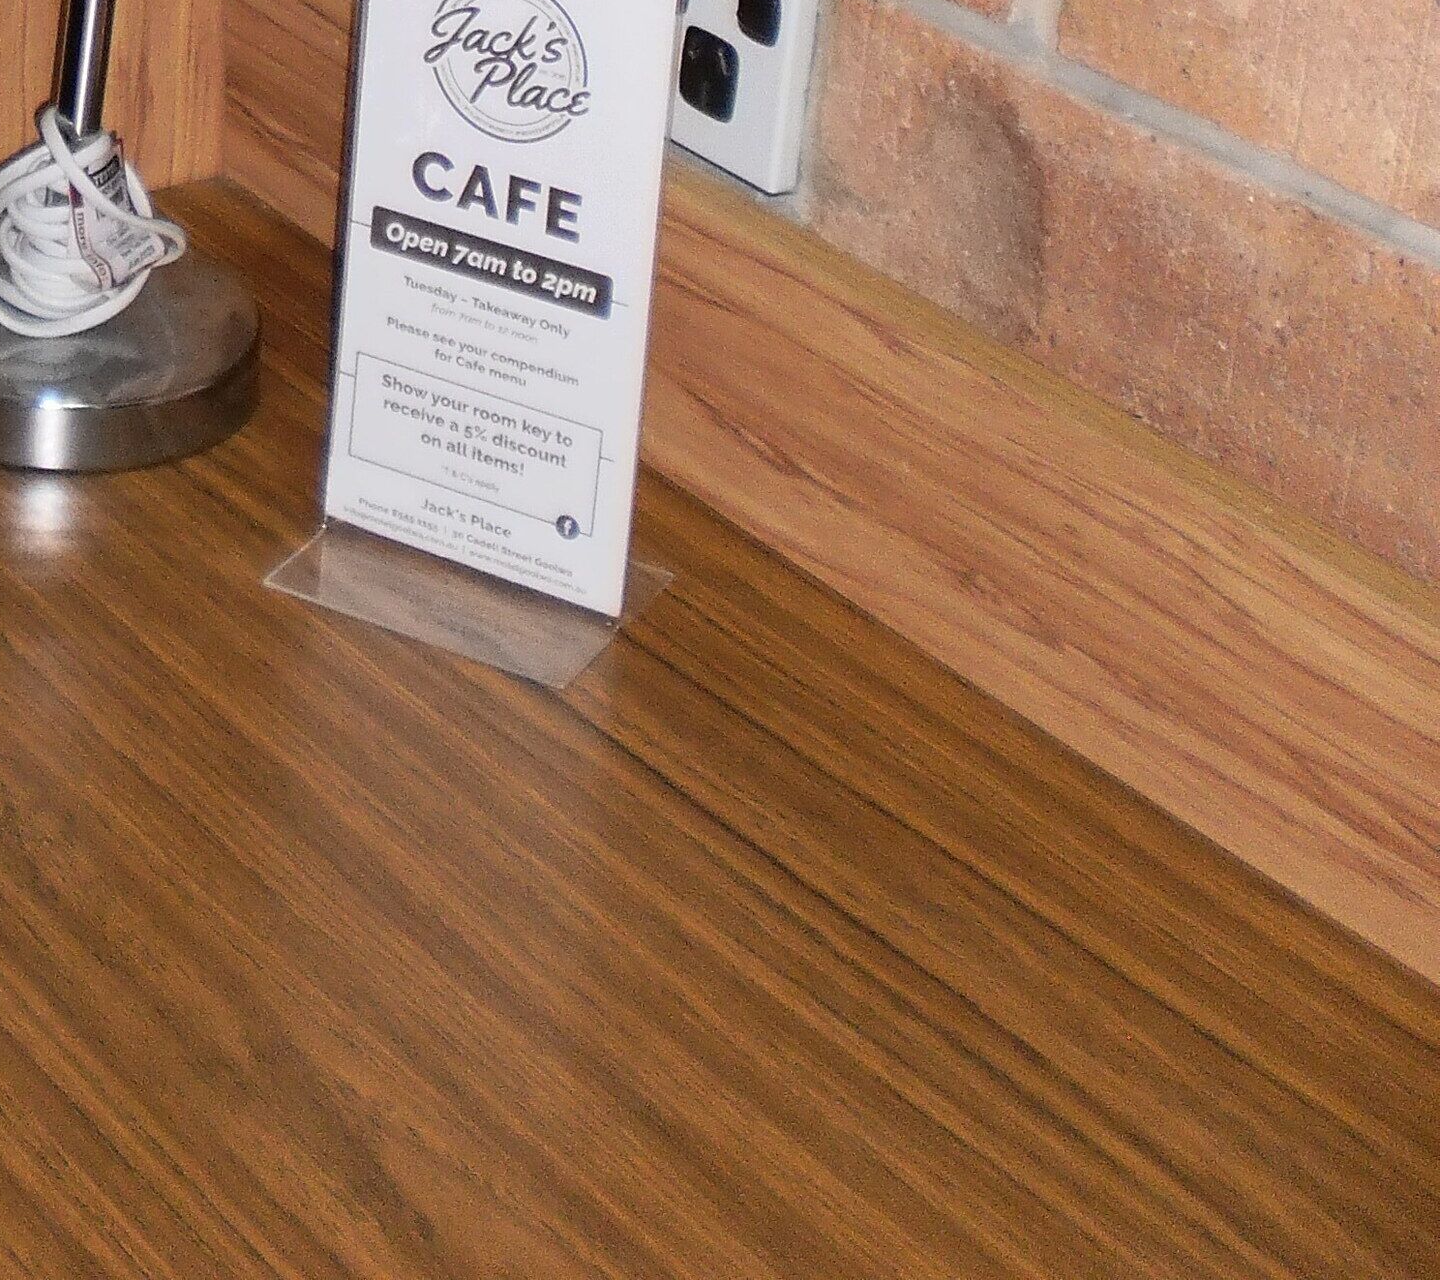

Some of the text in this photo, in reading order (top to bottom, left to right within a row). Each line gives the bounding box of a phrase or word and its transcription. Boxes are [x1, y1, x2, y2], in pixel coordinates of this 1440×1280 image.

[424, 6, 568, 65] Jack's
[470, 55, 591, 116] Place
[411, 151, 583, 244] CAFE
[385, 222, 598, 304] Open 7am to 2pm
[403, 276, 458, 304] Tuesday
[471, 297, 536, 328] Takeaway
[539, 318, 570, 340] Only
[386, 316, 580, 386] Please see your compendium
[434, 348, 453, 362] for
[488, 368, 527, 387] menu
[381, 373, 574, 448] Show your room key to
[382, 397, 568, 469] receive a 5% discount
[421, 432, 441, 449] on
[446, 440, 467, 458] all
[471, 445, 526, 477] items!
[421, 498, 467, 524] Jack's
[471, 514, 512, 539] Place
